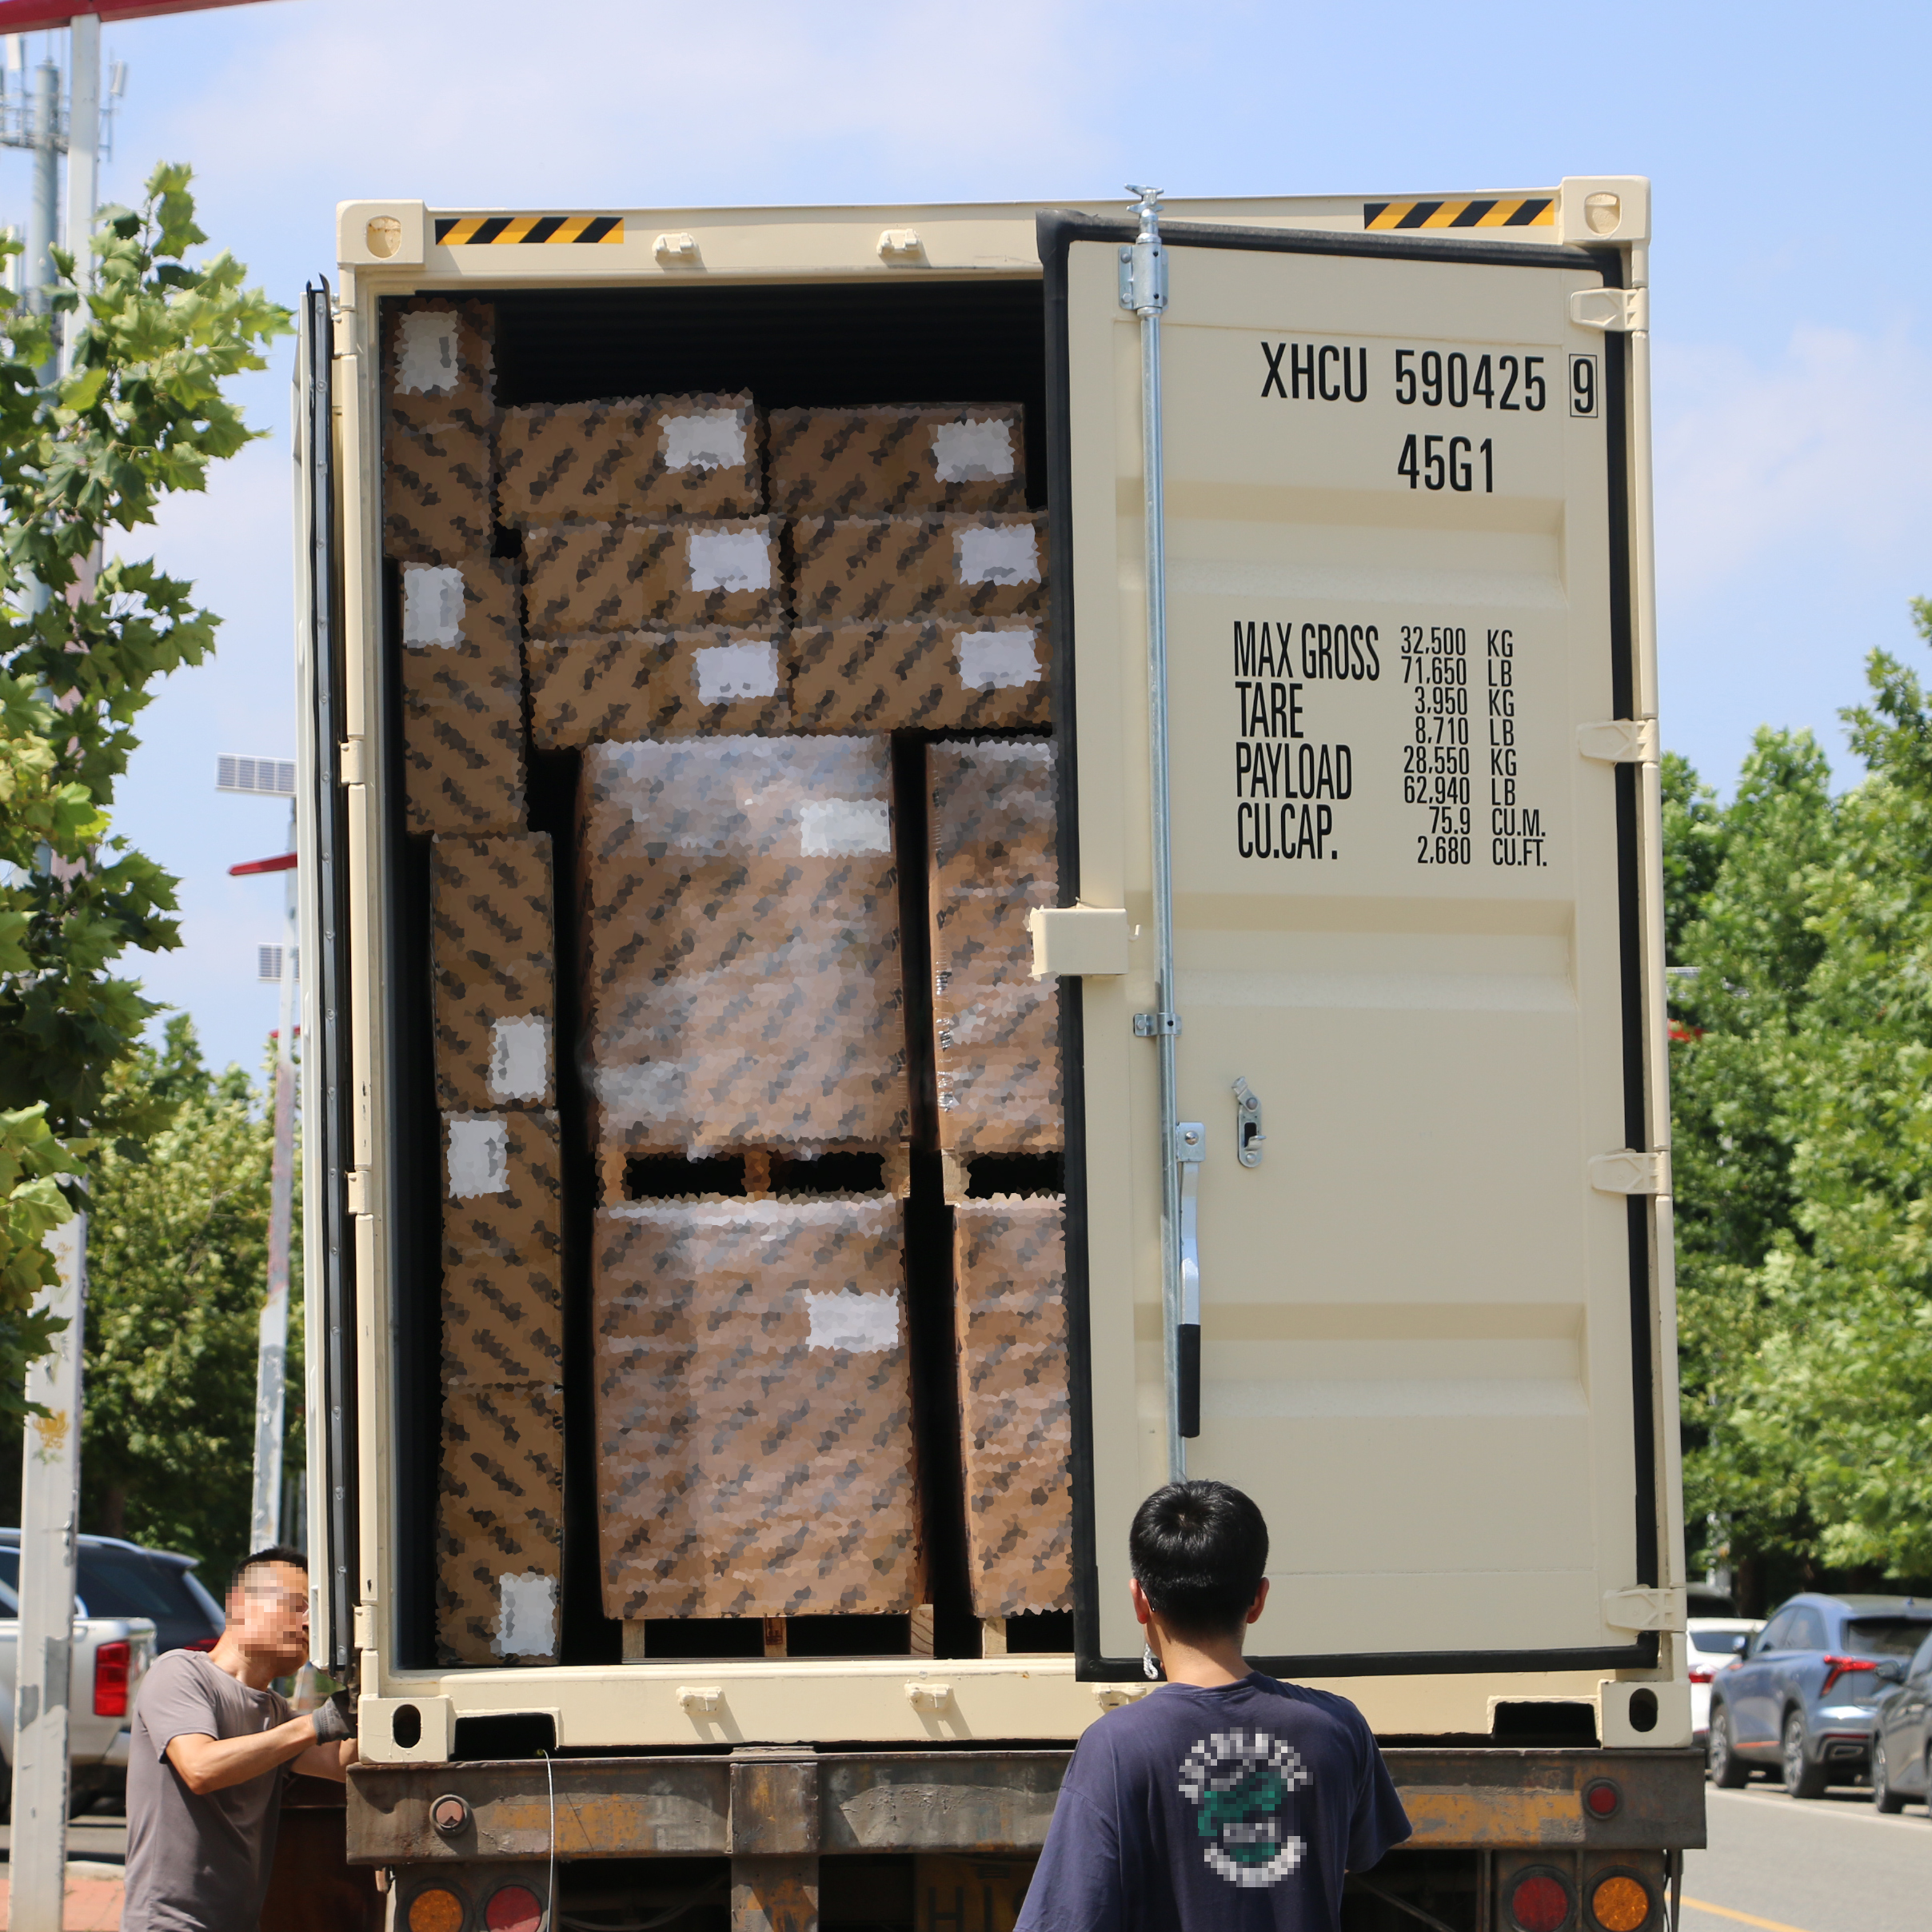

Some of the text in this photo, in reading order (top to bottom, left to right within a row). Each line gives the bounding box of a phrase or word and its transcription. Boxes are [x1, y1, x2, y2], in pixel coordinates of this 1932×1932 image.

[1260, 341, 1595, 414] XHCU 590425 9
[1397, 433, 1493, 493] 45G1
[1233, 621, 1513, 681] MAX GROSS 32,500 KG
[1400, 656, 1512, 688] 71,650 LB
[1235, 681, 1515, 739] TARE 3,950 KG
[1415, 715, 1515, 747] 8,710 LB
[1235, 741, 1517, 800] PAYLOAD 28,550 KG
[1403, 775, 1516, 806] 62,940 LB
[1237, 801, 1546, 860] CU.CAP. 75.9 CU.M.
[1417, 835, 1547, 867] 2,680 CU.FT.
[928, 1886, 1027, 1932] HI
